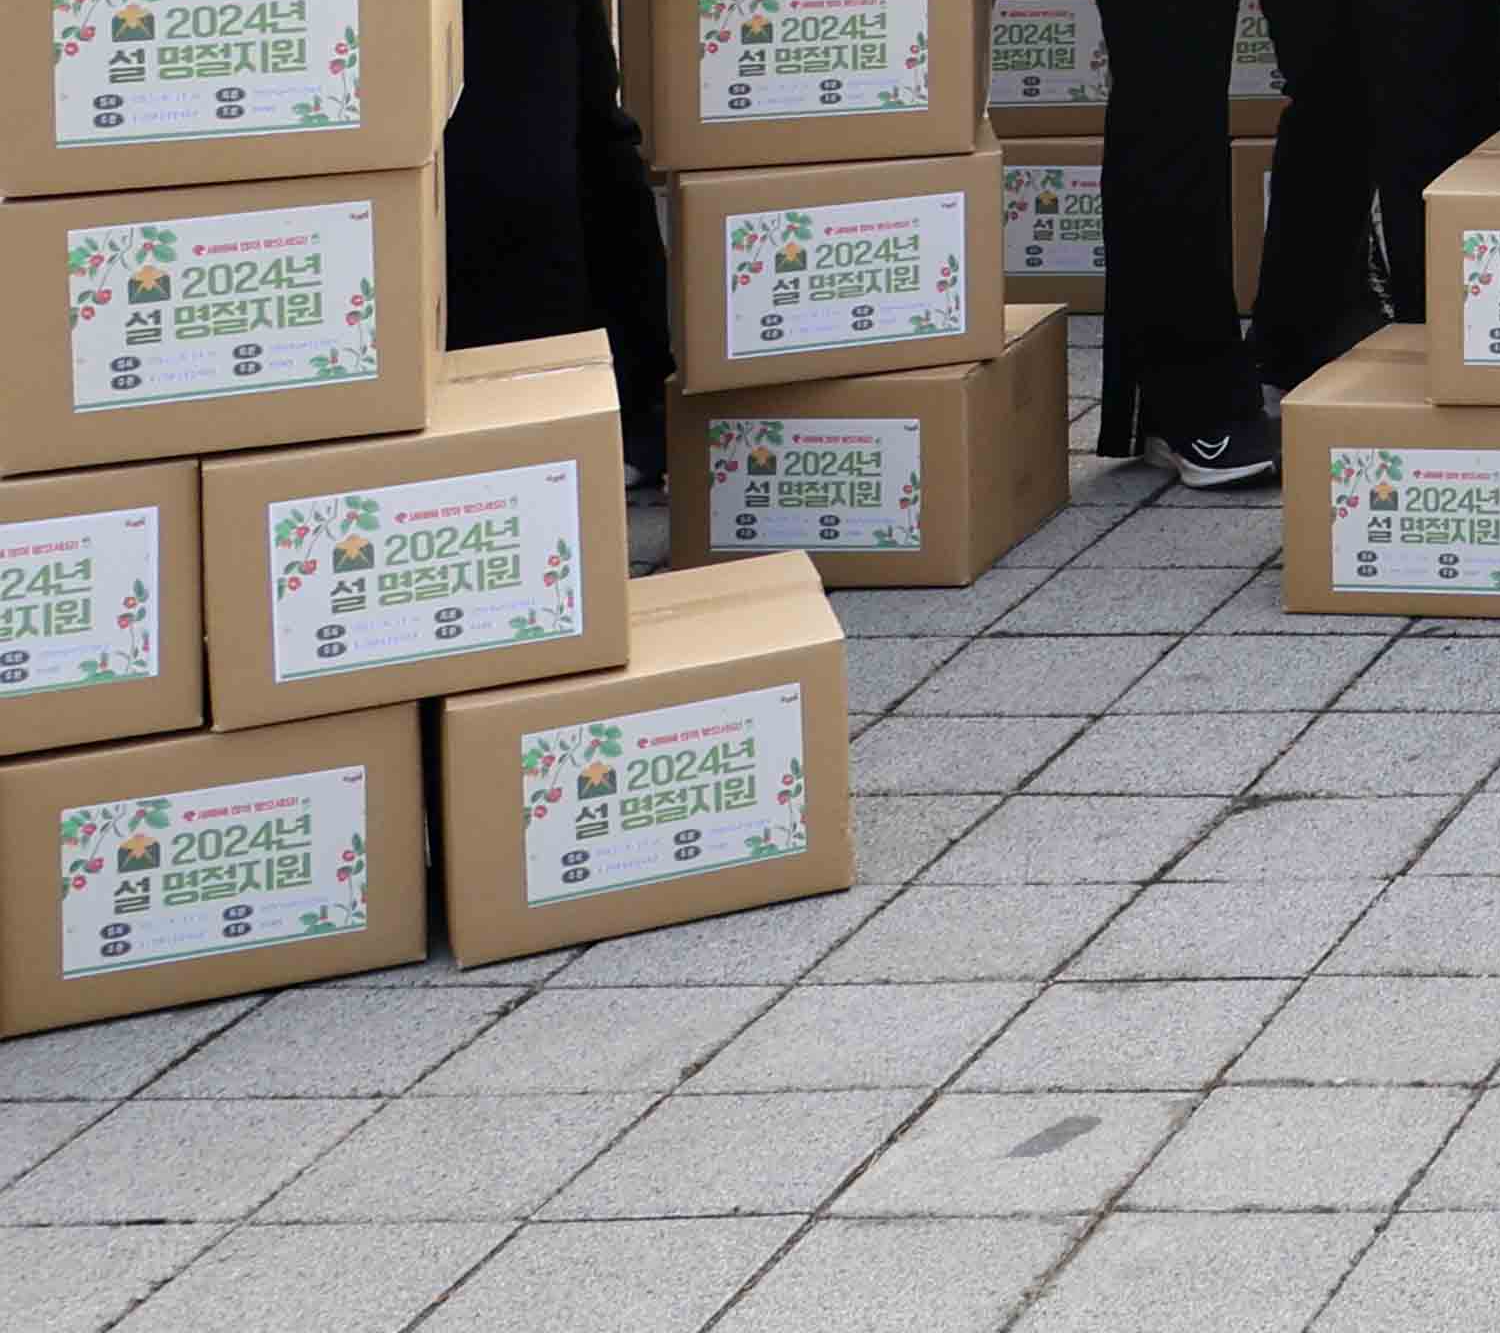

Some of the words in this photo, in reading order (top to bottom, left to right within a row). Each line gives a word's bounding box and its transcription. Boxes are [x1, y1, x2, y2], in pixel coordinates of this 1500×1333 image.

[166, 0, 305, 38] 2024년
[782, 13, 886, 42] 2024년
[108, 48, 145, 84] 설
[158, 38, 305, 80] 명절지원
[739, 49, 766, 76] 설
[775, 43, 886, 73] 명절지원
[815, 233, 920, 269] 2024년
[182, 253, 320, 298] 2024년
[771, 277, 799, 307] 설
[808, 265, 919, 302] 명절지원
[125, 309, 162, 346] 설
[174, 292, 321, 340] 명절지원
[784, 452, 881, 476] 2024년
[745, 481, 770, 506] 설
[779, 481, 881, 506] 명절지원
[1405, 486, 1499, 514] 2024년
[385, 515, 520, 565] 2024년
[1367, 516, 1391, 544] 설
[1400, 517, 1499, 546] 명절지원
[329, 577, 365, 615] 설
[377, 554, 520, 607] 명절지원
[627, 737, 754, 790] 2024년
[575, 802, 609, 841] 설
[620, 775, 755, 830] 명절지원
[172, 815, 310, 865] 2024년
[115, 876, 151, 913] 설
[164, 852, 311, 904] 명절지원
